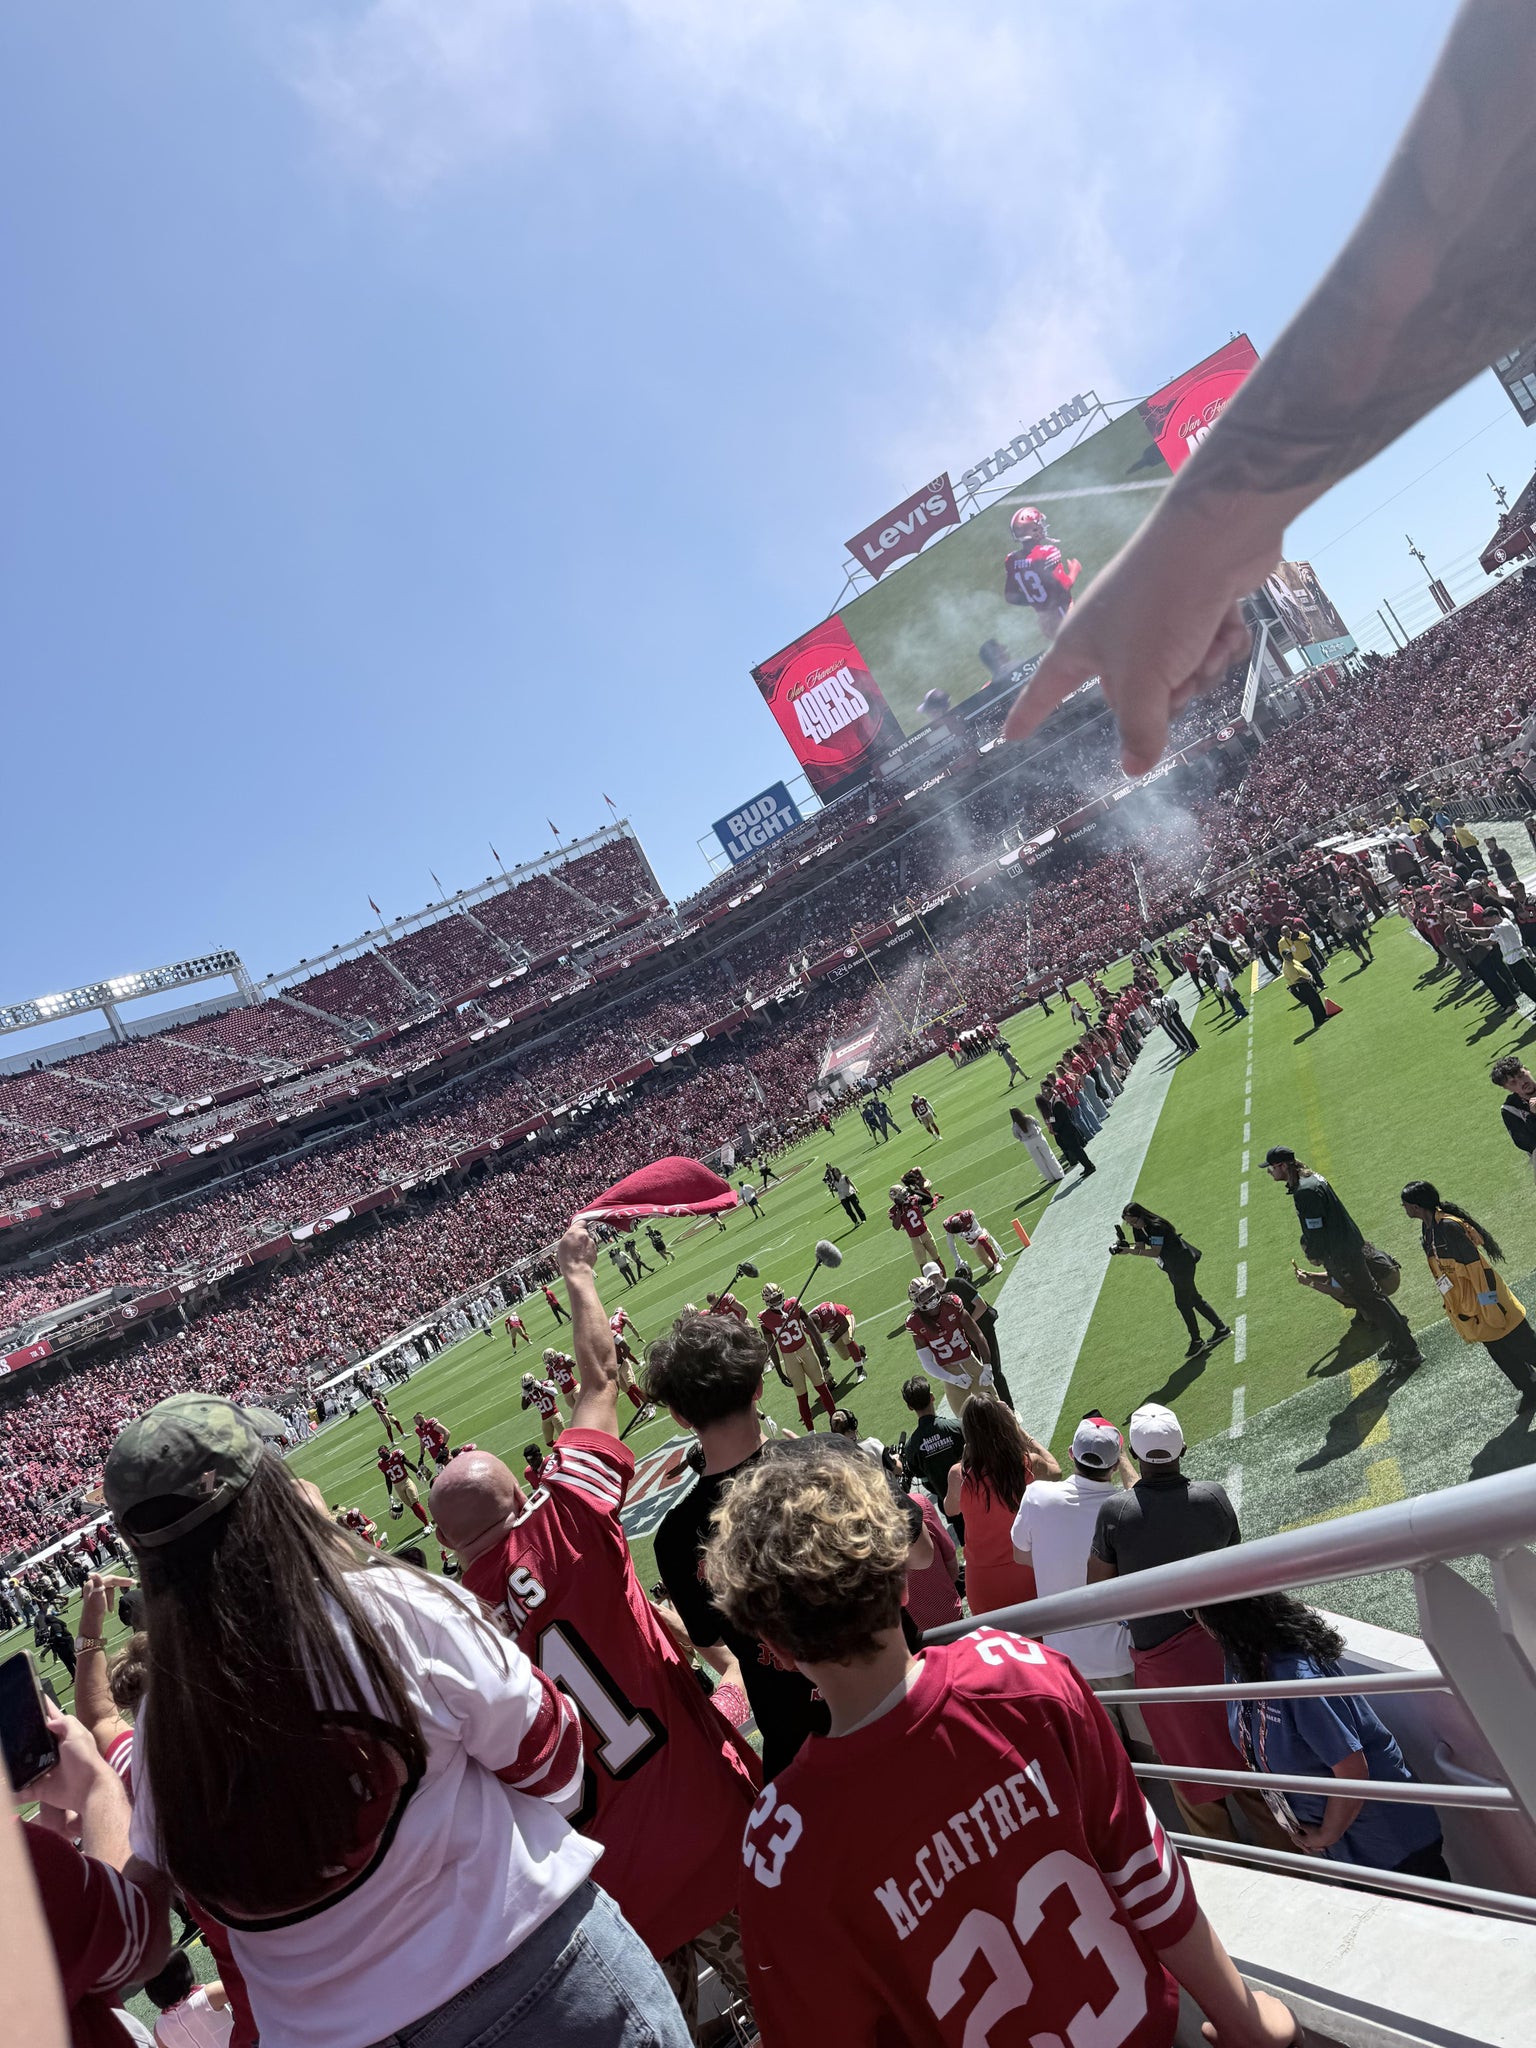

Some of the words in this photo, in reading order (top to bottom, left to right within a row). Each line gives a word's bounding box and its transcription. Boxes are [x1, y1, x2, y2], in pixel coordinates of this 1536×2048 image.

[960, 393, 1090, 494] STADIUM
[1014, 570, 1048, 603] 13
[793, 666, 870, 746] 49ERS
[727, 796, 777, 837] BUD
[727, 805, 795, 860] LIGHT
[1070, 822, 1097, 841] NetApp
[1035, 846, 1054, 860] bank
[885, 928, 915, 949] verizon
[906, 1210, 922, 1229] 2
[774, 1318, 803, 1347] 53
[929, 1327, 969, 1360] 54
[554, 1369, 571, 1386] 26
[534, 1396, 553, 1414] 20
[421, 1434, 436, 1450] 51
[386, 1464, 405, 1482] 33
[960, 1624, 1049, 1667] 2
[741, 1782, 803, 1889] 23
[872, 1757, 1060, 1941] McCAFFREY
[926, 1849, 1149, 2048] 23
